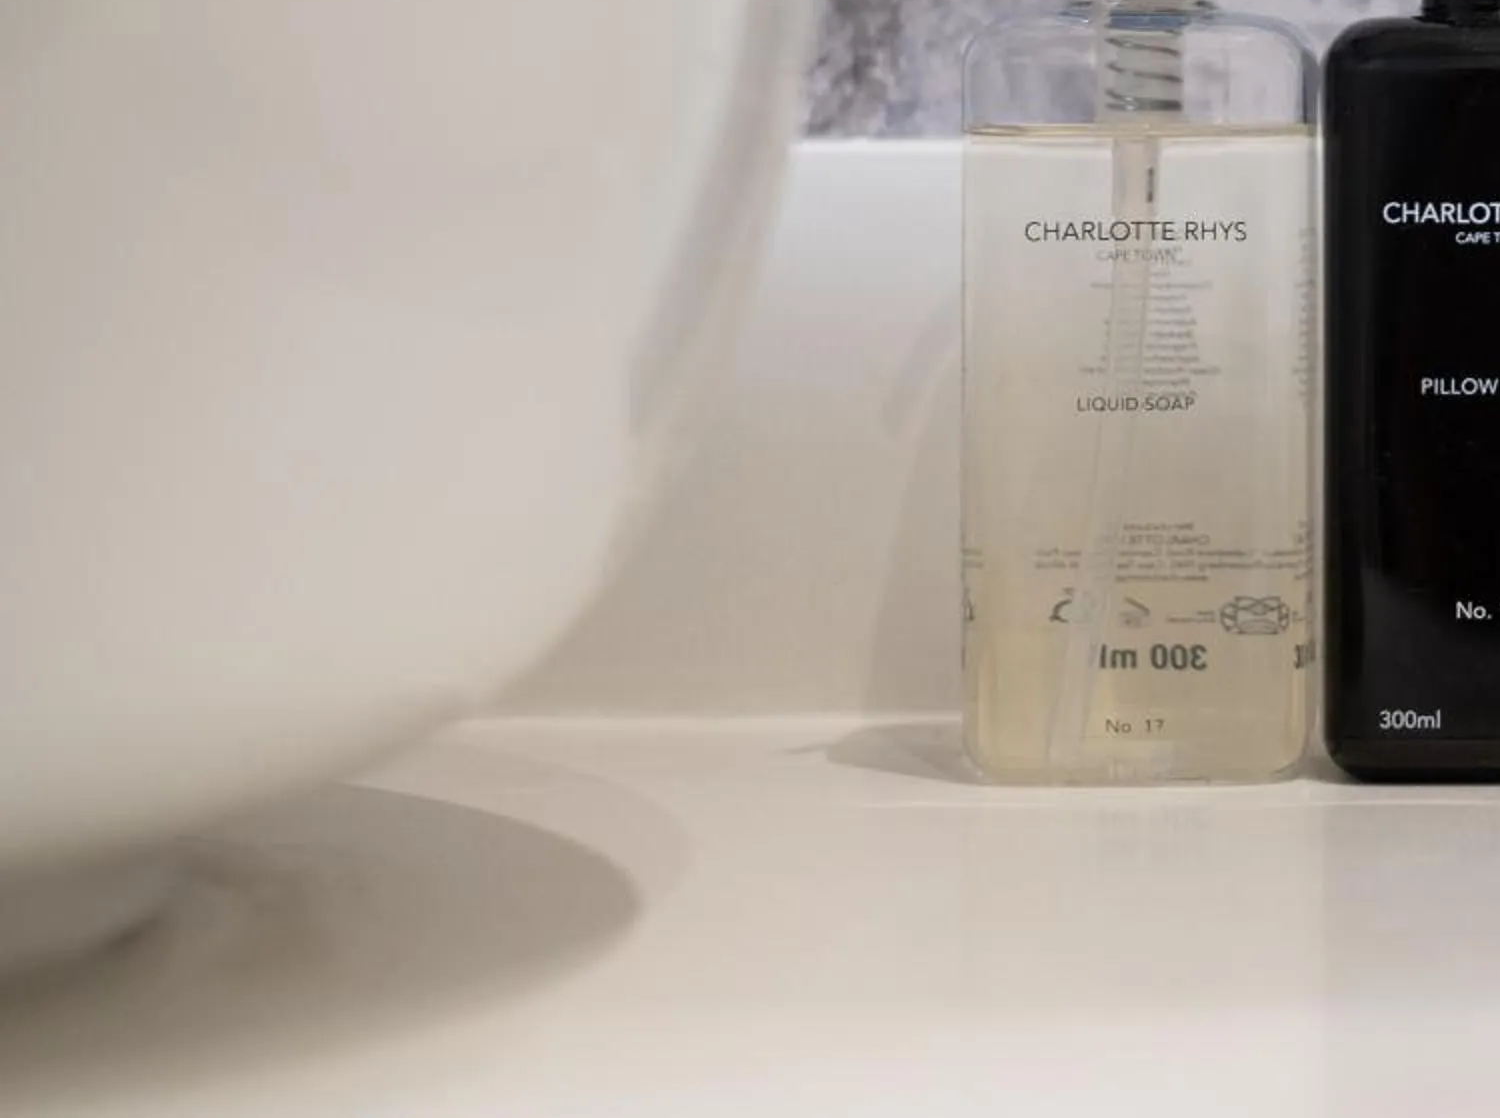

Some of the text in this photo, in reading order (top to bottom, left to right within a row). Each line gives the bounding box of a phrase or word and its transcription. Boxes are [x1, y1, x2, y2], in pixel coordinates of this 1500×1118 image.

[1024, 221, 1247, 242] CHARLOTTE RHYS
[1455, 231, 1490, 245] CAPE
[1420, 377, 1499, 396] PILLOW
[1077, 396, 1195, 412] LIQUID SOAP
[1455, 600, 1493, 620] No.
[1145, 719, 1165, 733] 17
[1379, 709, 1441, 730] 300ml
